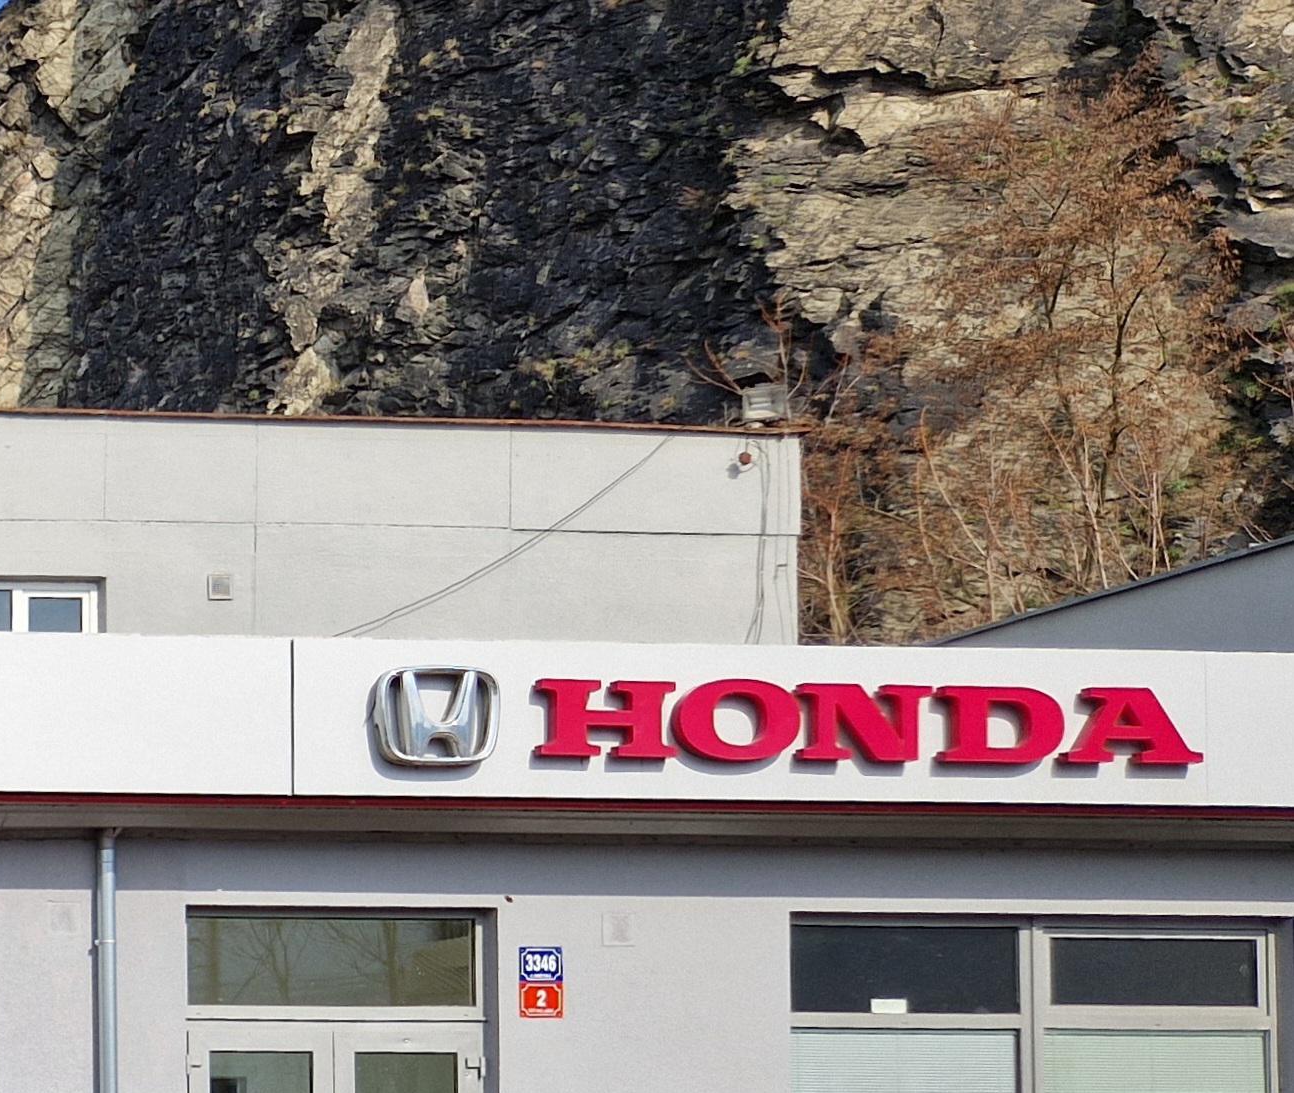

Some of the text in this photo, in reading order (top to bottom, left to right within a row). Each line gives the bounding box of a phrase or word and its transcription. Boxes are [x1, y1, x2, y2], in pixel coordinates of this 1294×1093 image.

[532, 678, 1203, 766] HONDA
[525, 954, 557, 972] 3346
[536, 989, 547, 1008] 2
